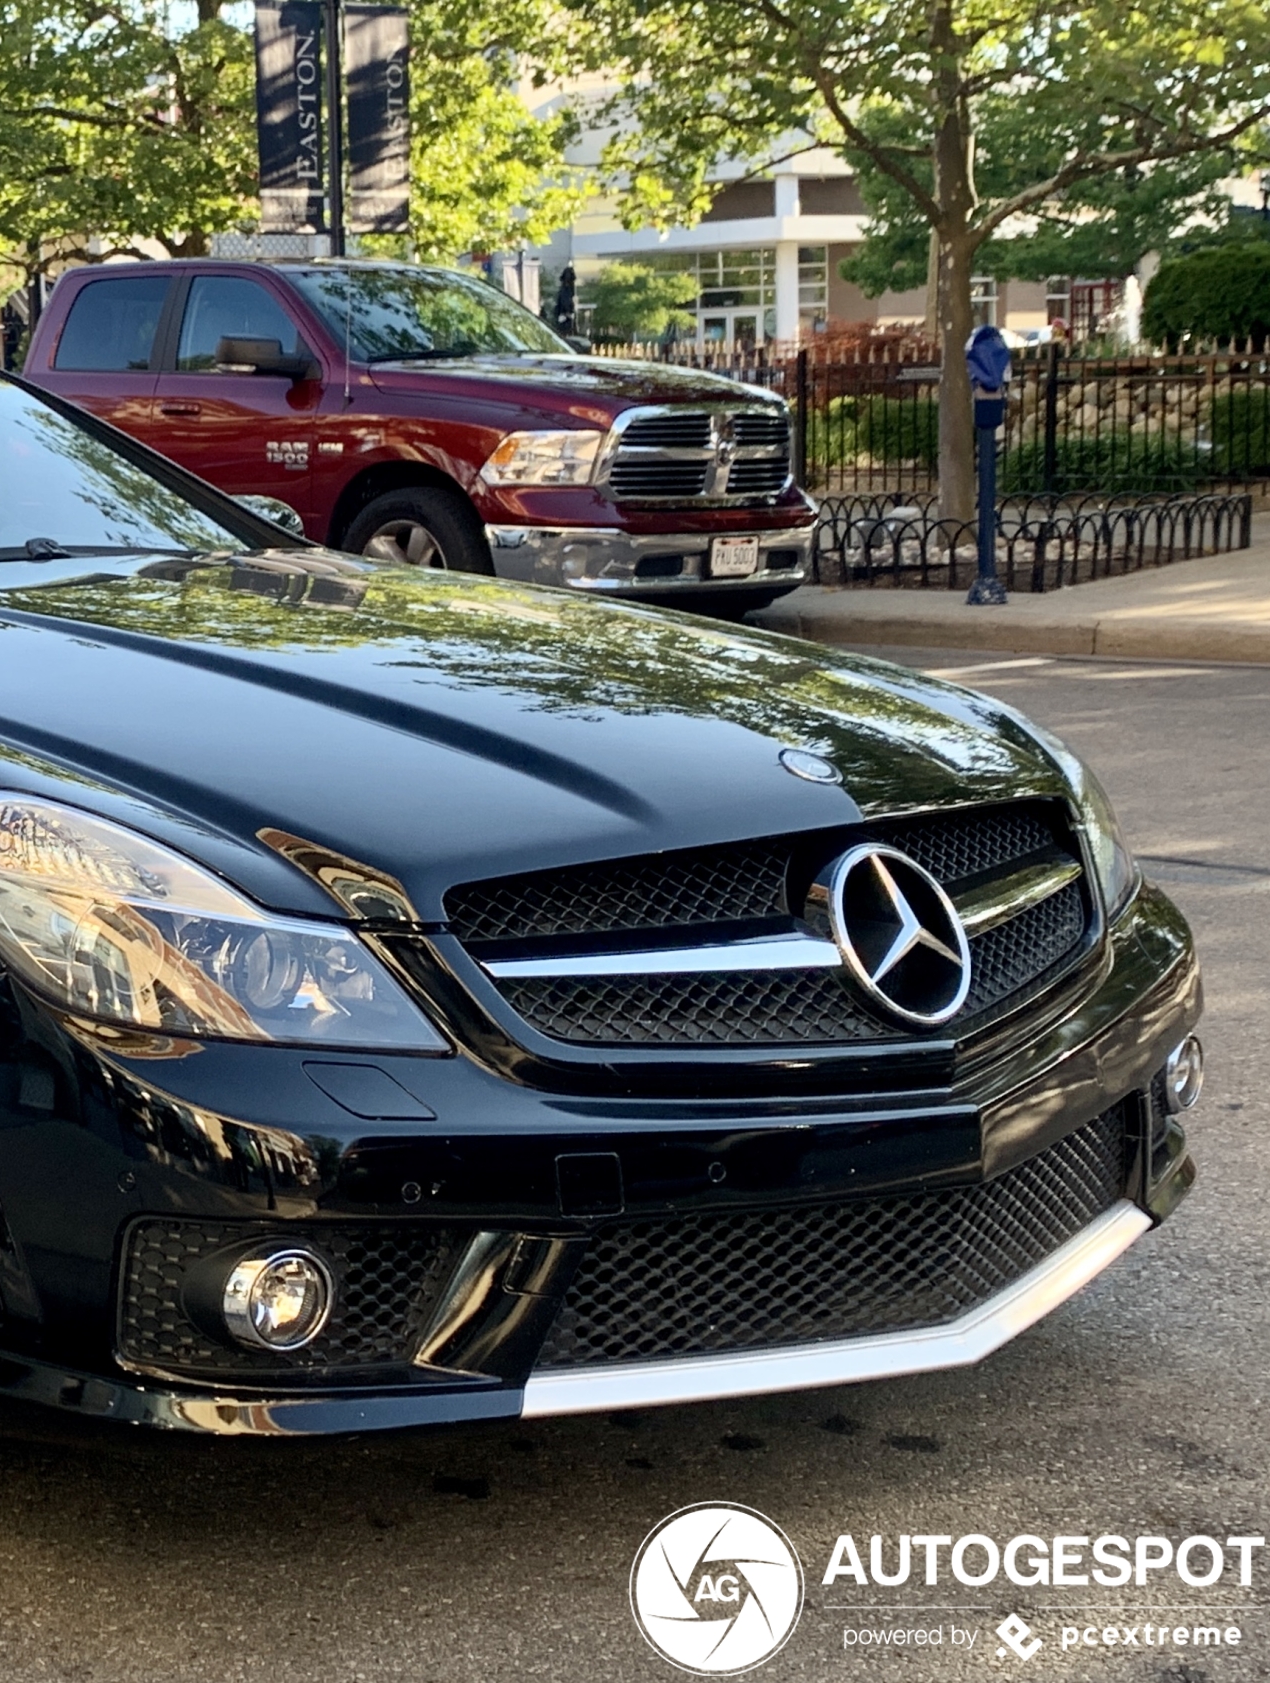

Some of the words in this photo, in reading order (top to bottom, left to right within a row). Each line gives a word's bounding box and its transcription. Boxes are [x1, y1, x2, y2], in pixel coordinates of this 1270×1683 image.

[297, 33, 318, 179] EASTON
[266, 441, 309, 453] RAM
[266, 452, 309, 464] 1500
